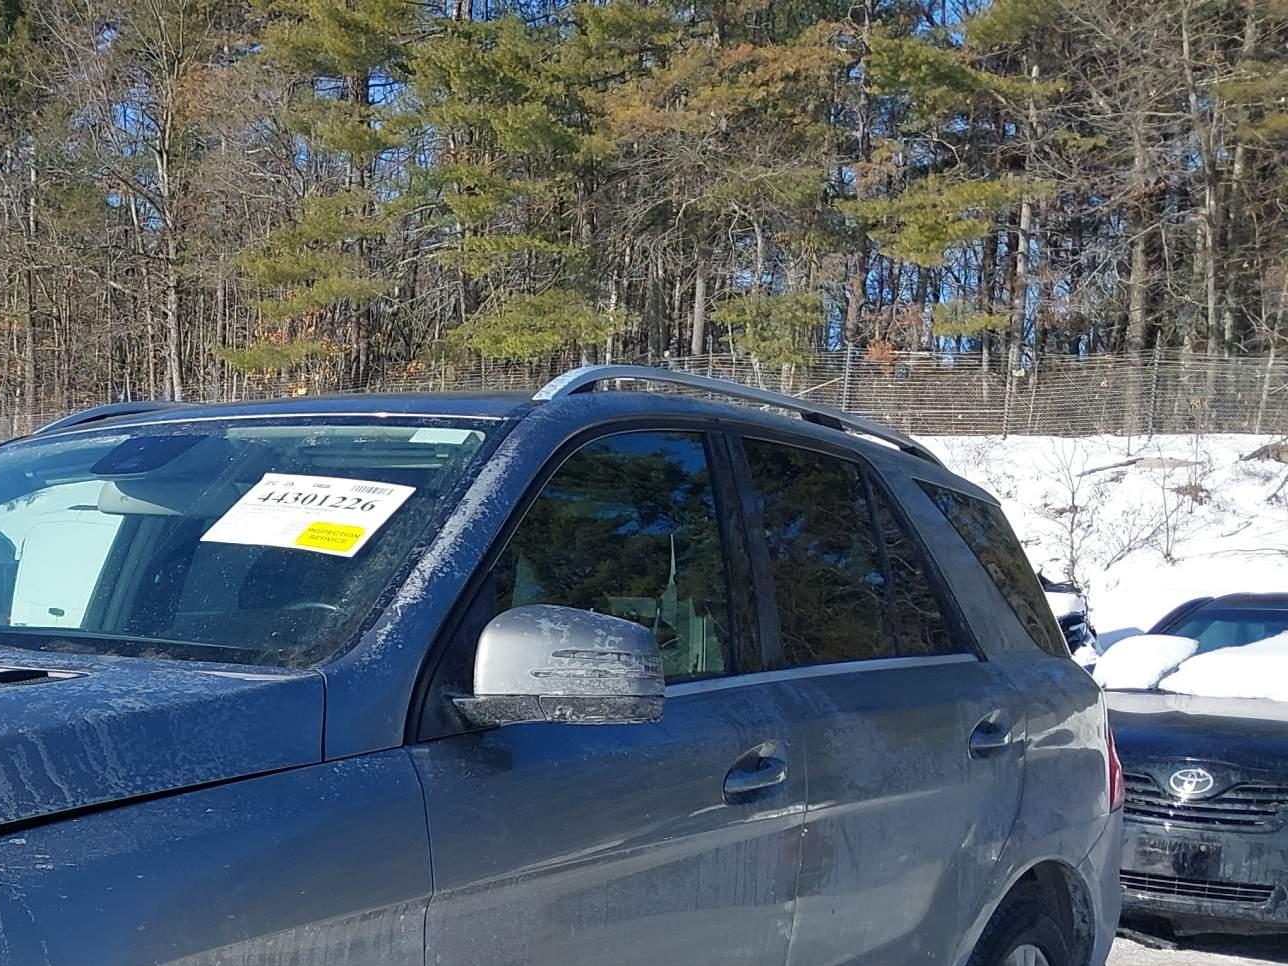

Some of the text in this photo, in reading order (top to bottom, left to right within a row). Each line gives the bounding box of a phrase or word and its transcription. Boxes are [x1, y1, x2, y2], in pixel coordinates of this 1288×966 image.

[257, 490, 381, 512] 44301226
[307, 527, 361, 539] INSPECTION
[309, 534, 347, 544] SERVICE
